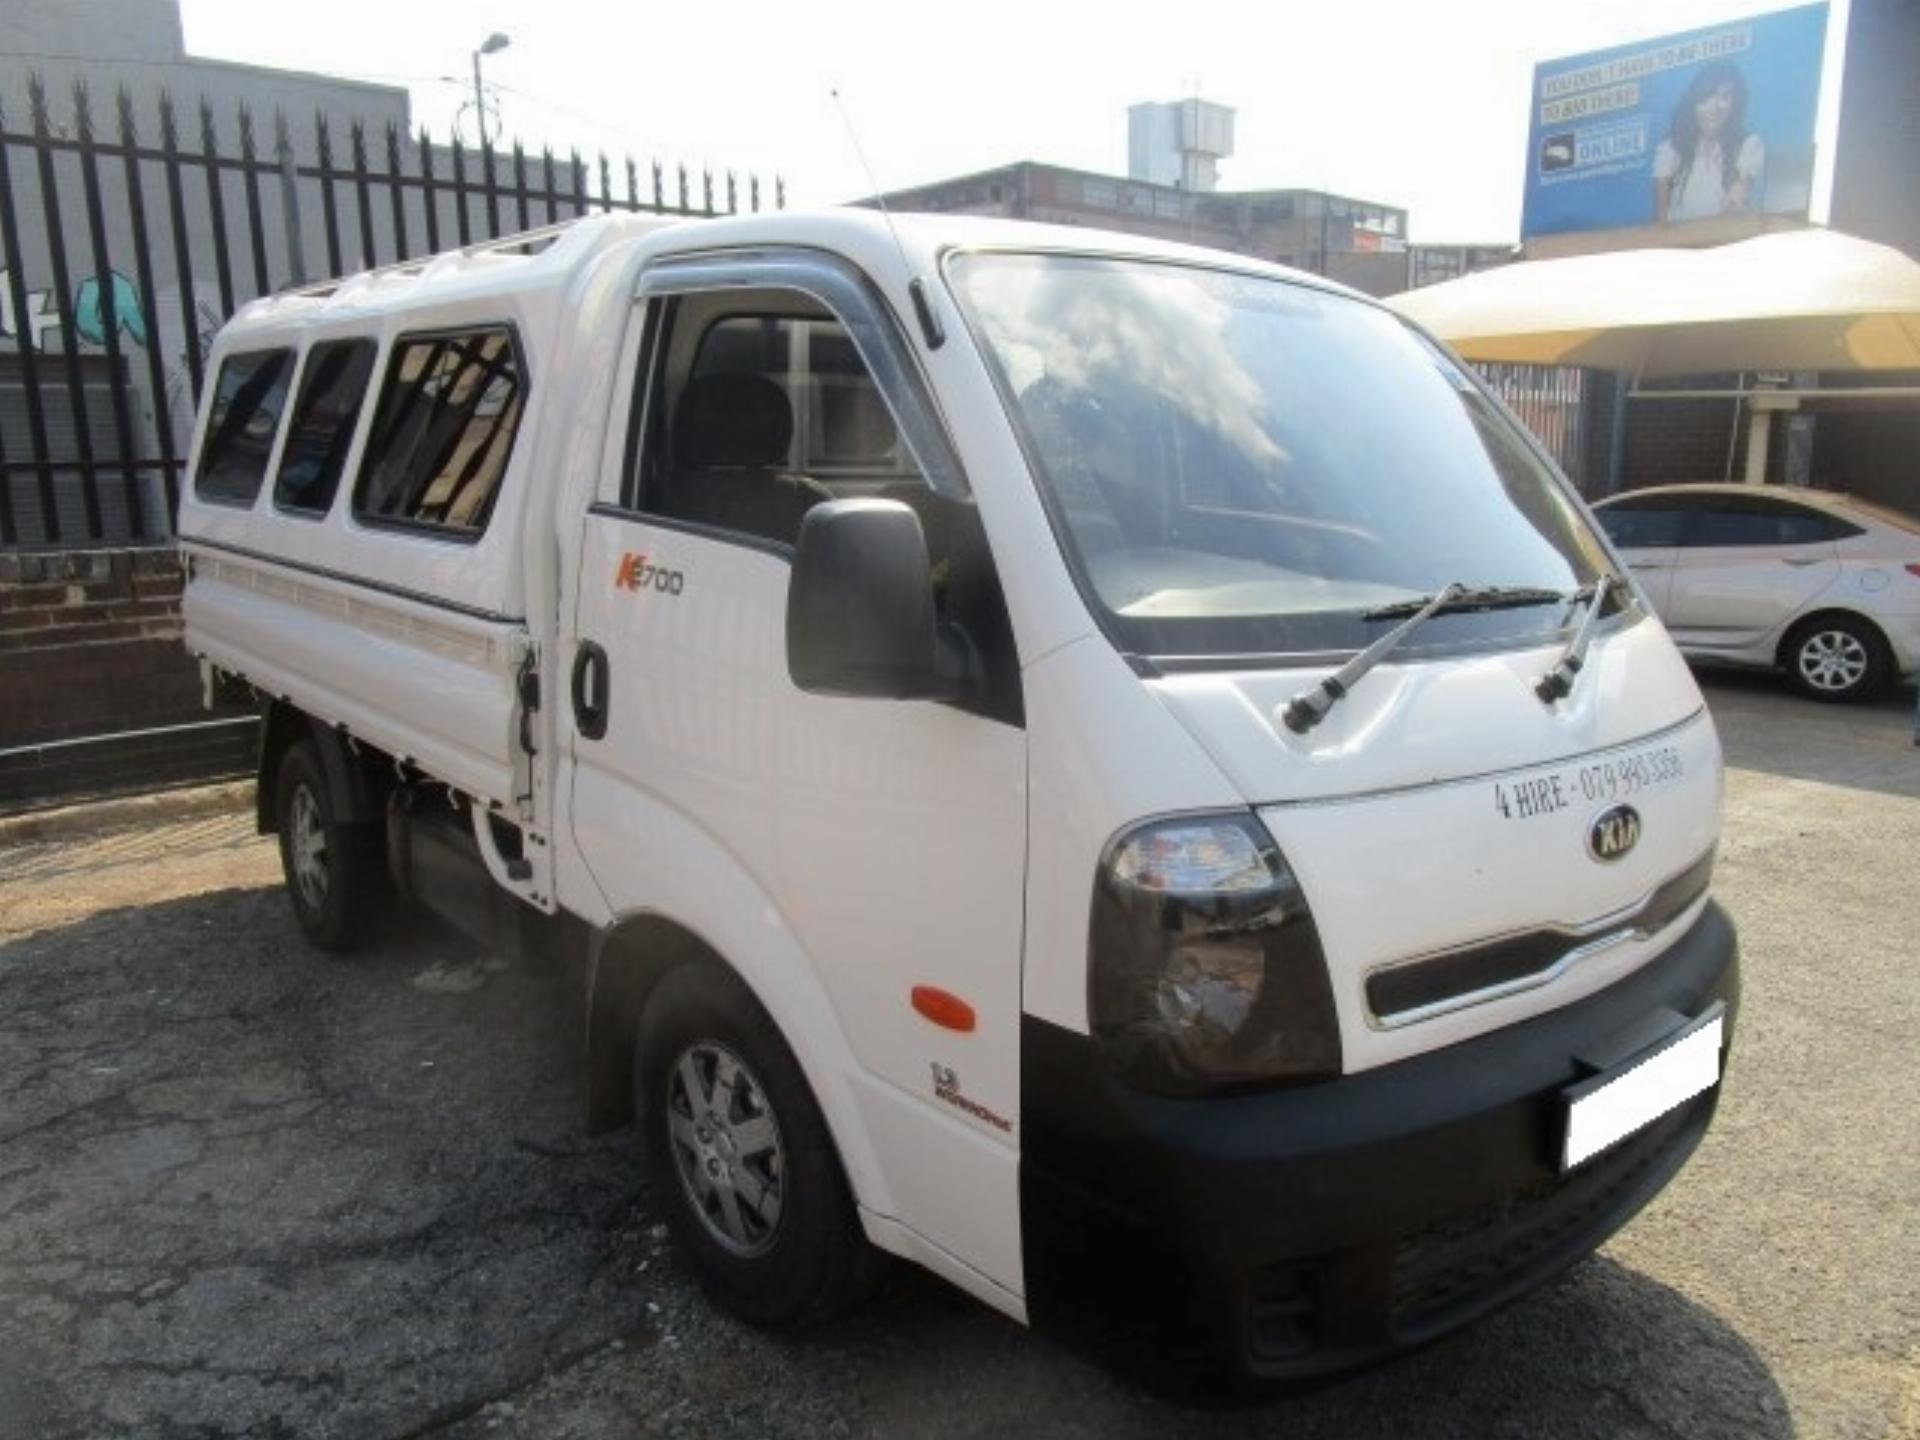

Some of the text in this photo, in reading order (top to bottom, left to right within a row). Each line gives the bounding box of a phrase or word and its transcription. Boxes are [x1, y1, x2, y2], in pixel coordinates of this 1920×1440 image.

[615, 552, 684, 596] K2700
[1495, 783, 1511, 819] 4
[1513, 775, 1568, 818] HIRE
[1598, 814, 1639, 855] KIA
